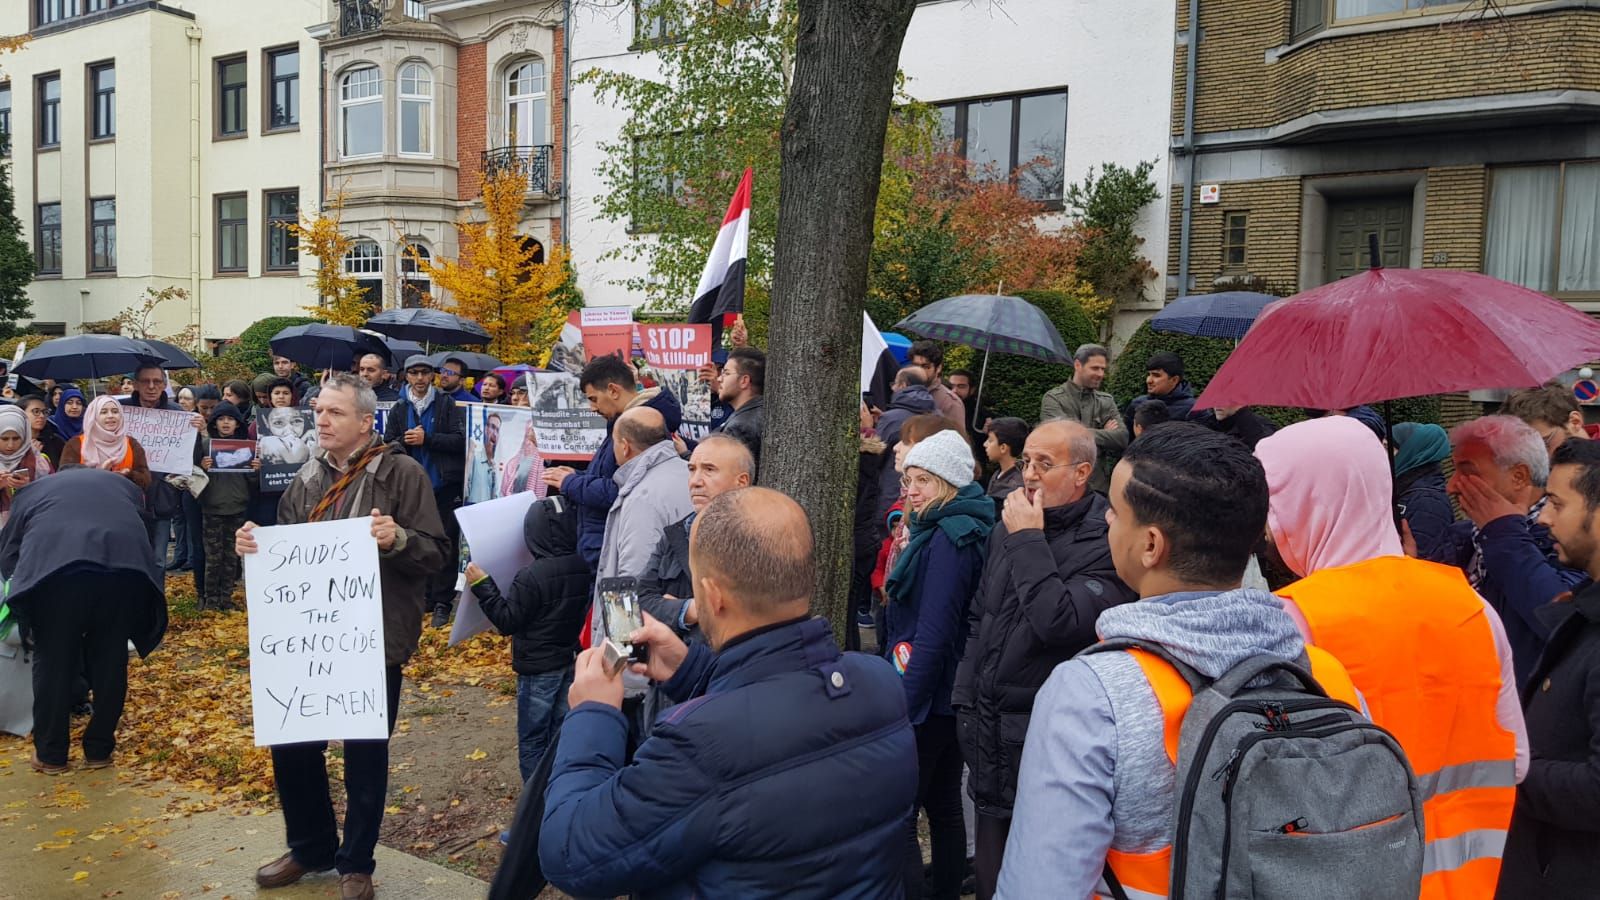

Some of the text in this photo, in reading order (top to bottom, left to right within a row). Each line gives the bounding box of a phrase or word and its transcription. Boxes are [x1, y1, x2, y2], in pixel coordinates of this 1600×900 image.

[647, 327, 695, 350] STOP
[646, 351, 708, 367] the Killing!
[554, 420, 581, 428] combat
[268, 537, 350, 571] SAUDIS
[263, 572, 376, 604] STOP NOW
[301, 608, 341, 625] THE
[260, 626, 377, 656] GENOCIDE
[309, 656, 333, 677] IN
[265, 671, 384, 730] YEMEN!
